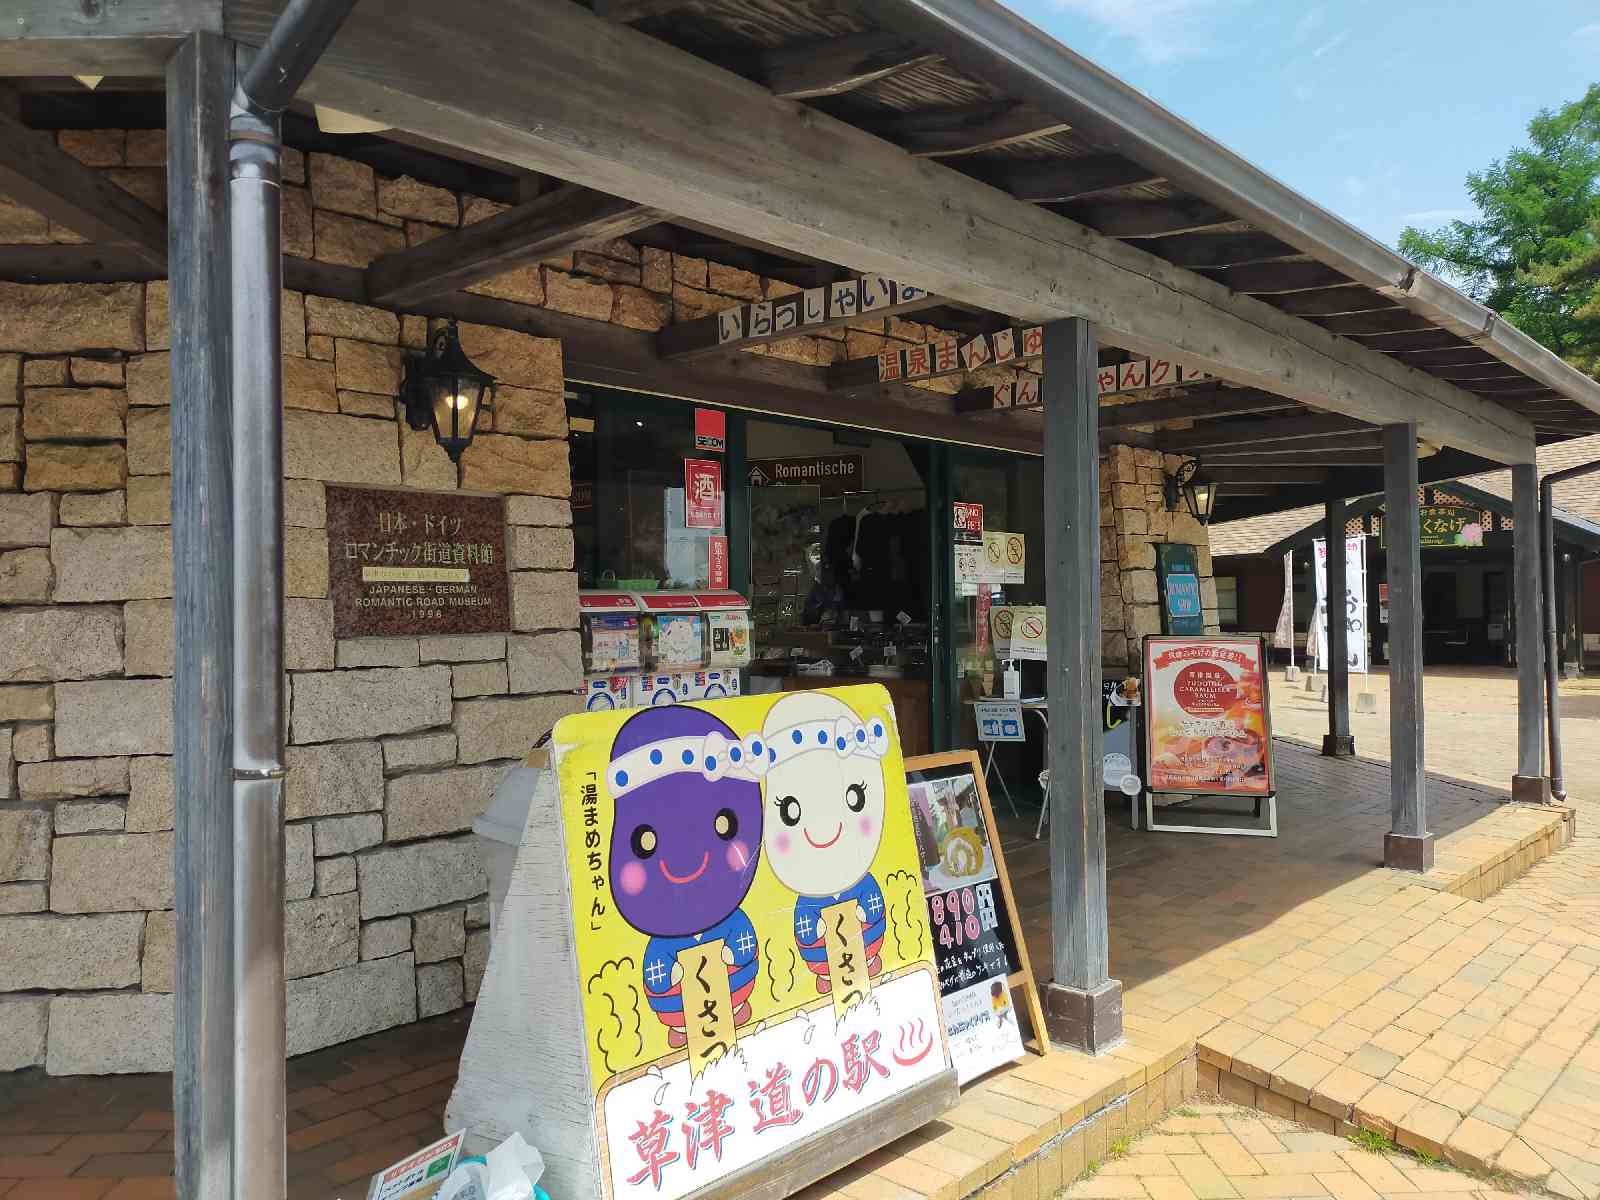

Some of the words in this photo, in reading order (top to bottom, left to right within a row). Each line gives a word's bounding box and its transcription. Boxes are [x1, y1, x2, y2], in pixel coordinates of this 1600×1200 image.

[775, 460, 855, 479] Romantische
[345, 542, 495, 565] ロマンチック街道資料館
[355, 598, 414, 608] ROMANTIC
[416, 598, 445, 608] ROAD
[449, 598, 492, 608] MUSEUM
[836, 913, 863, 1004] くさつ
[696, 956, 728, 1058] くさつ
